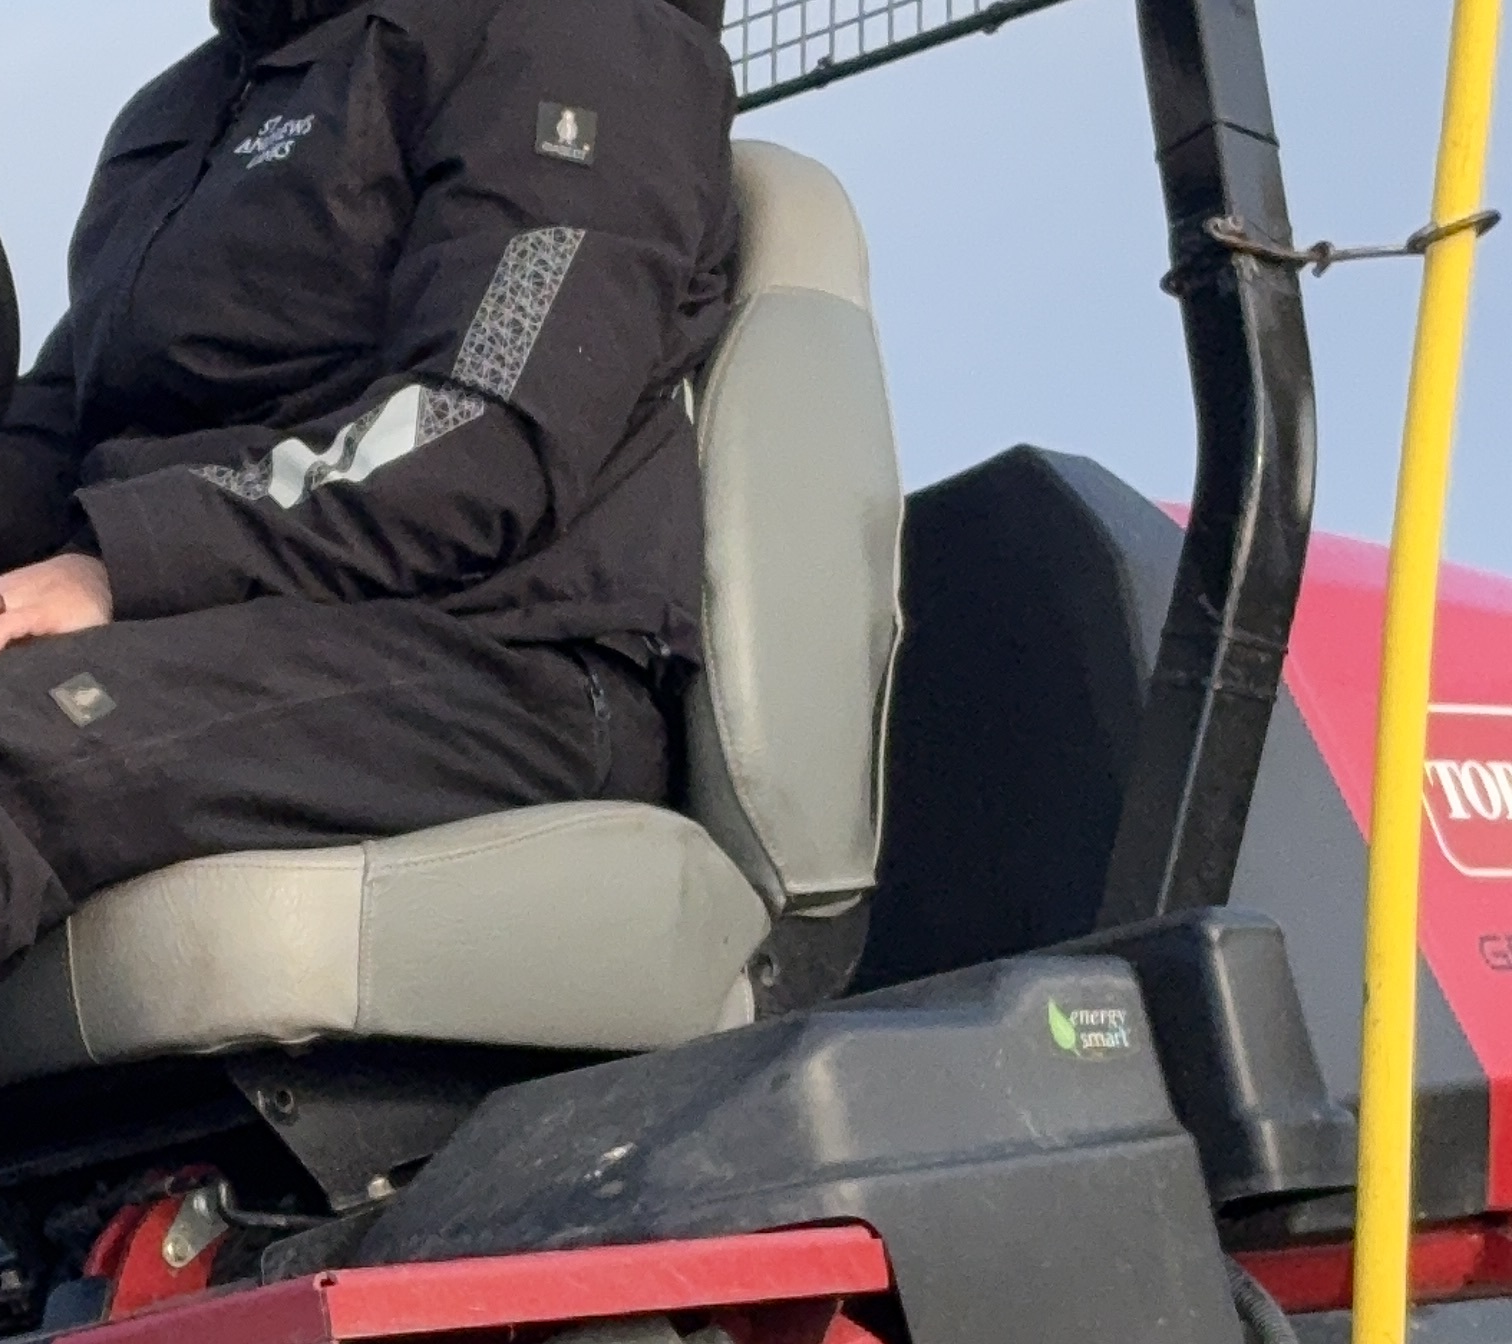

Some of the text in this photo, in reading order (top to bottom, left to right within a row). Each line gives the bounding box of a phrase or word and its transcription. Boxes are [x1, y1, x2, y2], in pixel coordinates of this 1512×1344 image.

[1478, 934, 1512, 971] G
[1069, 1009, 1126, 1029] energy
[1080, 1025, 1131, 1049] smart
